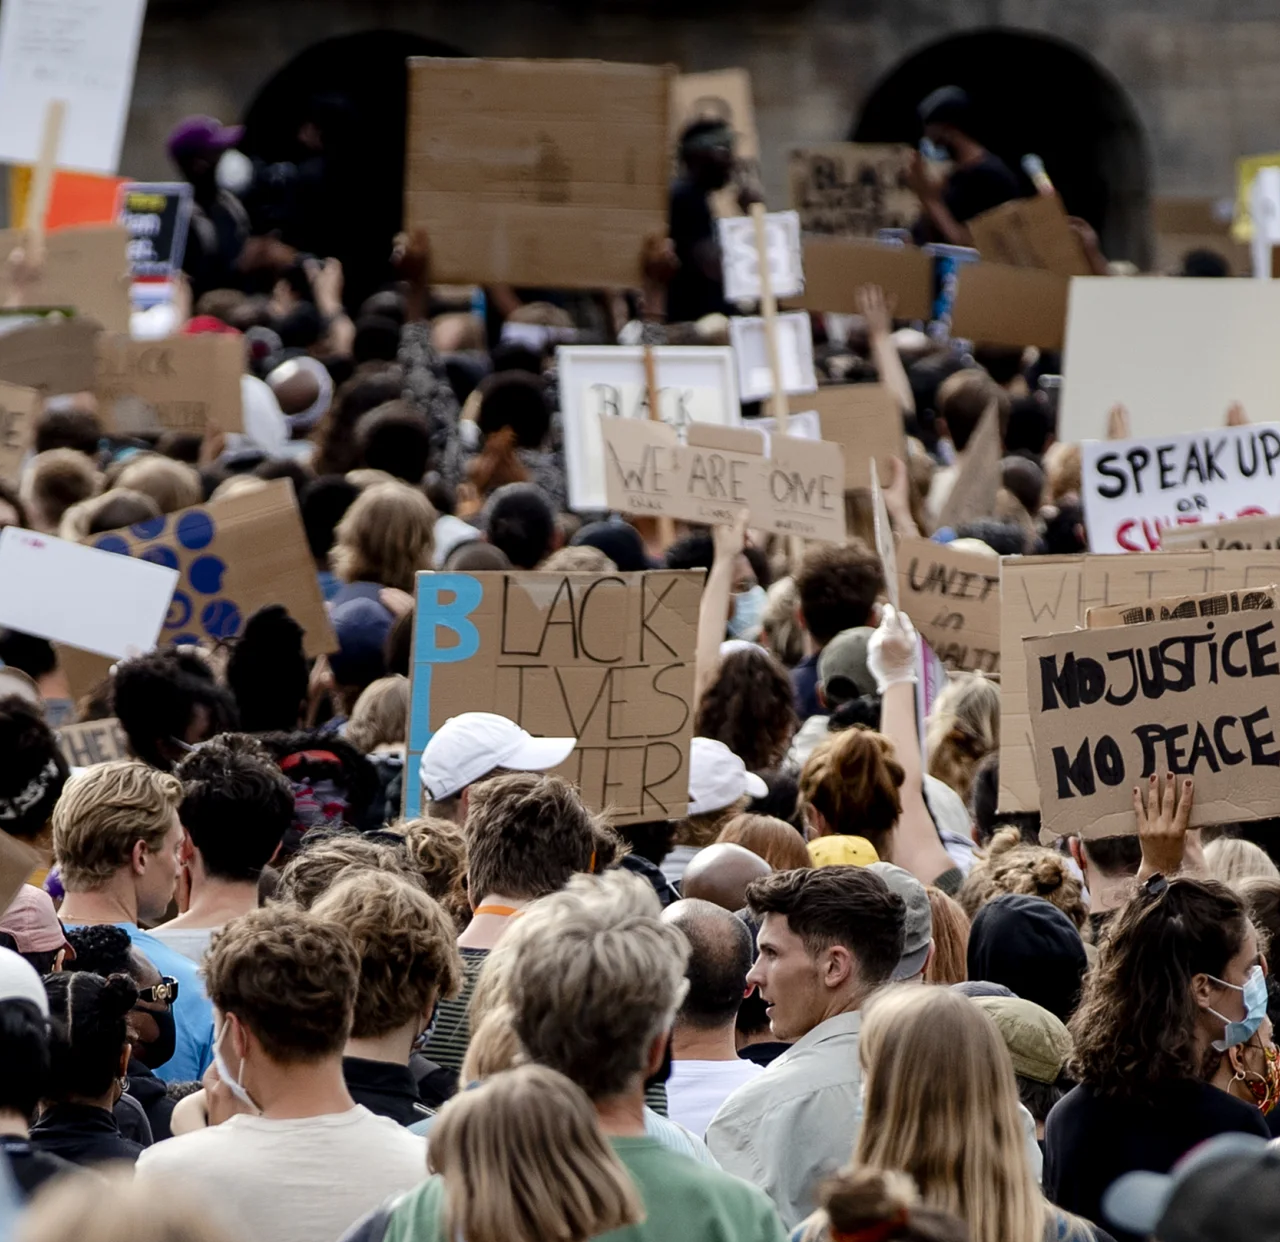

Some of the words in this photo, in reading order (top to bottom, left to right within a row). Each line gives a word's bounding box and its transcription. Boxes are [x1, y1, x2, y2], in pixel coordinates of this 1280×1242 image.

[607, 439, 669, 493] WE
[687, 453, 750, 502] ARE
[770, 468, 836, 512] ONE
[1096, 437, 1228, 499] SPEAK
[1176, 493, 1208, 513] OR
[413, 572, 680, 664] BLACK
[1039, 651, 1107, 713] NO
[1051, 733, 1126, 801] NO
